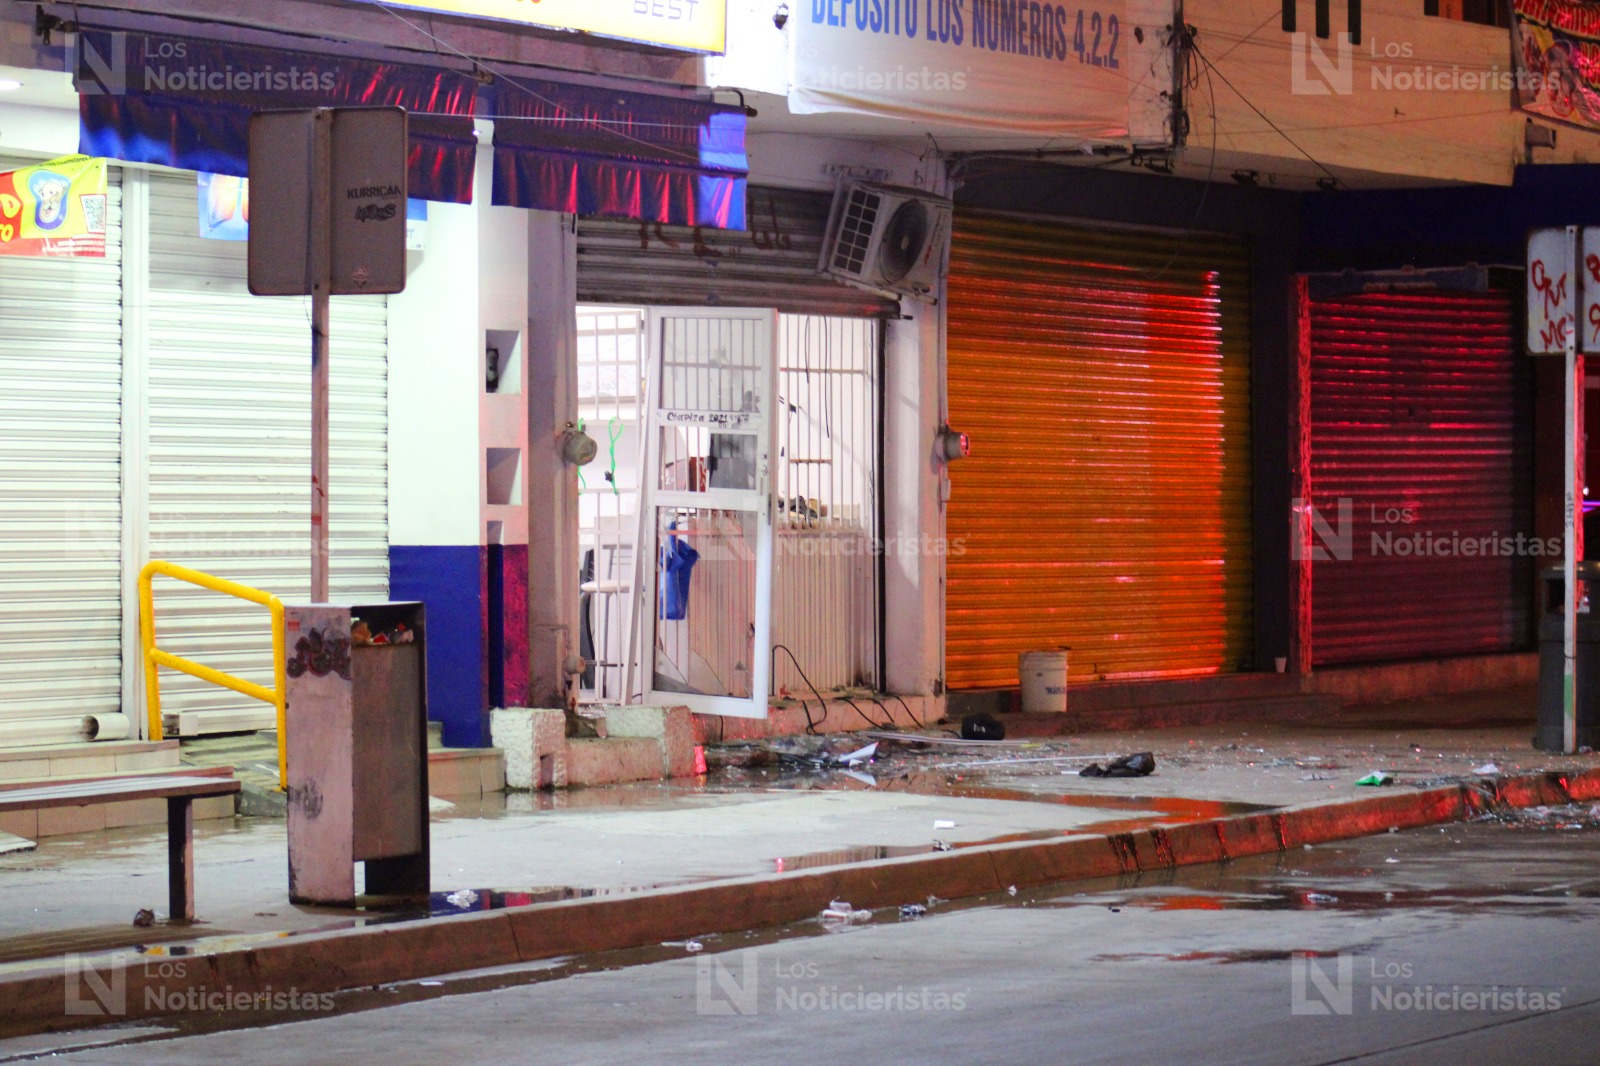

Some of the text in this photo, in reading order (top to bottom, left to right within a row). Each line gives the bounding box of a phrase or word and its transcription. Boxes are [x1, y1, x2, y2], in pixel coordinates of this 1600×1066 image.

[926, 0, 964, 46] LOS
[972, 0, 1067, 61] NUMEROS
[1073, 9, 1120, 69] 4.2.2
